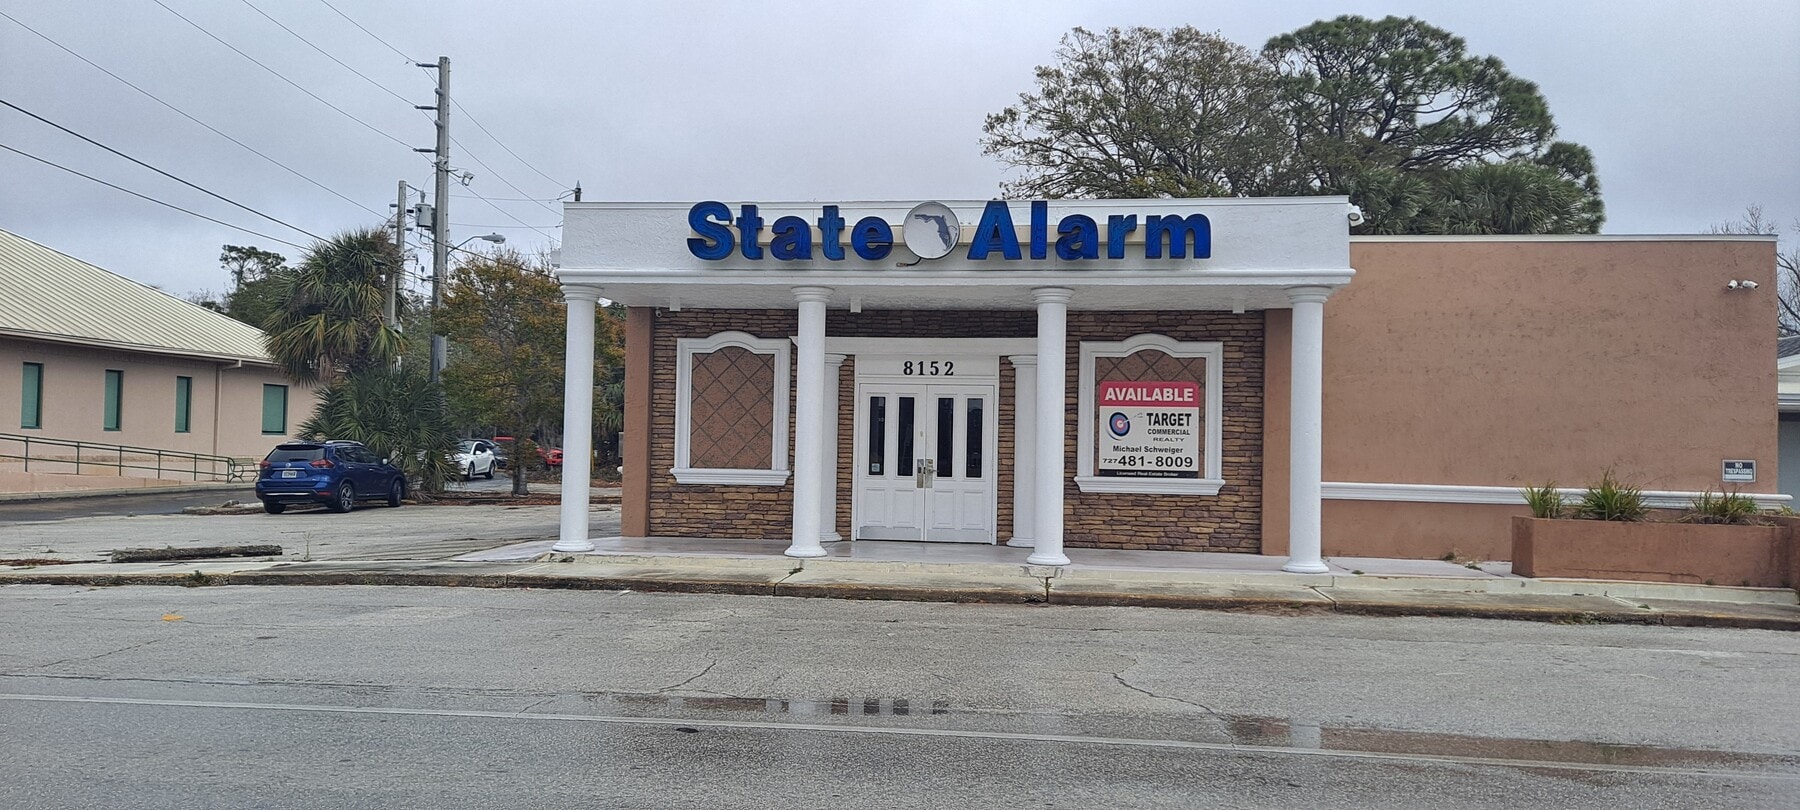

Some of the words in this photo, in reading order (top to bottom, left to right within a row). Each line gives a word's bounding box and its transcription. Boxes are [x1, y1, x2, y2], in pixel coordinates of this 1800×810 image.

[686, 201, 893, 261] State
[967, 200, 1212, 261] Alarm
[903, 361, 954, 376] 8152
[1104, 387, 1194, 402] AVAILABLE
[1146, 413, 1192, 427] TARGET
[1147, 428, 1190, 436] COMMERCIAL
[1112, 445, 1142, 453] Michael
[1144, 446, 1184, 454] Schweiger
[1118, 455, 1193, 468] 481-8009
